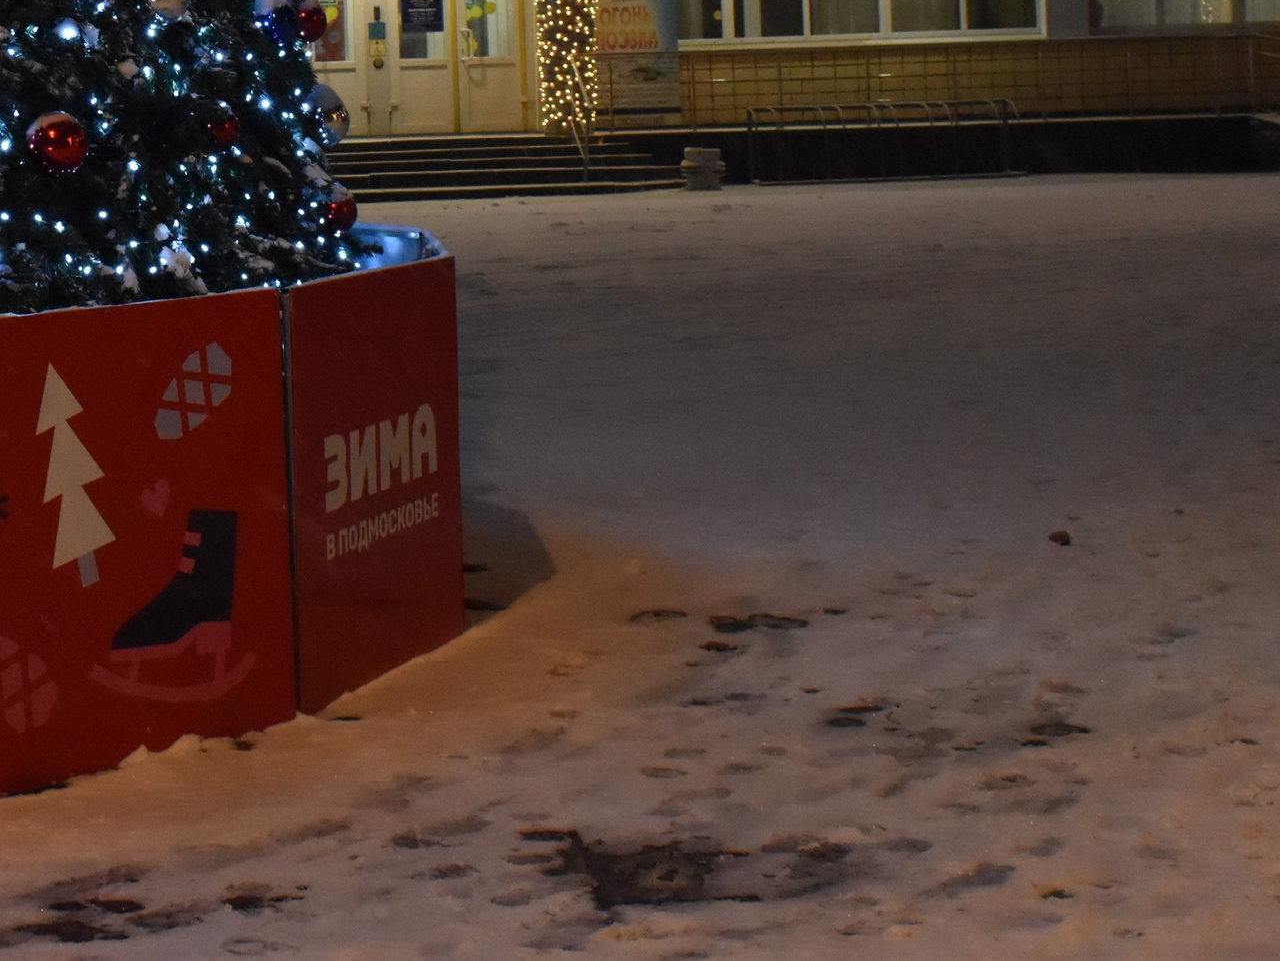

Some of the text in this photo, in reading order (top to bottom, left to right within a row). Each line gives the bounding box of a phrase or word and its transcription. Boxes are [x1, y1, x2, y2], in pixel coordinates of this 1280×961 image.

[599, 6, 651, 26] ОГОНЬ
[324, 403, 438, 513] ЗИМА
[326, 493, 439, 561] В ПОДМОСКОВЬЕ
